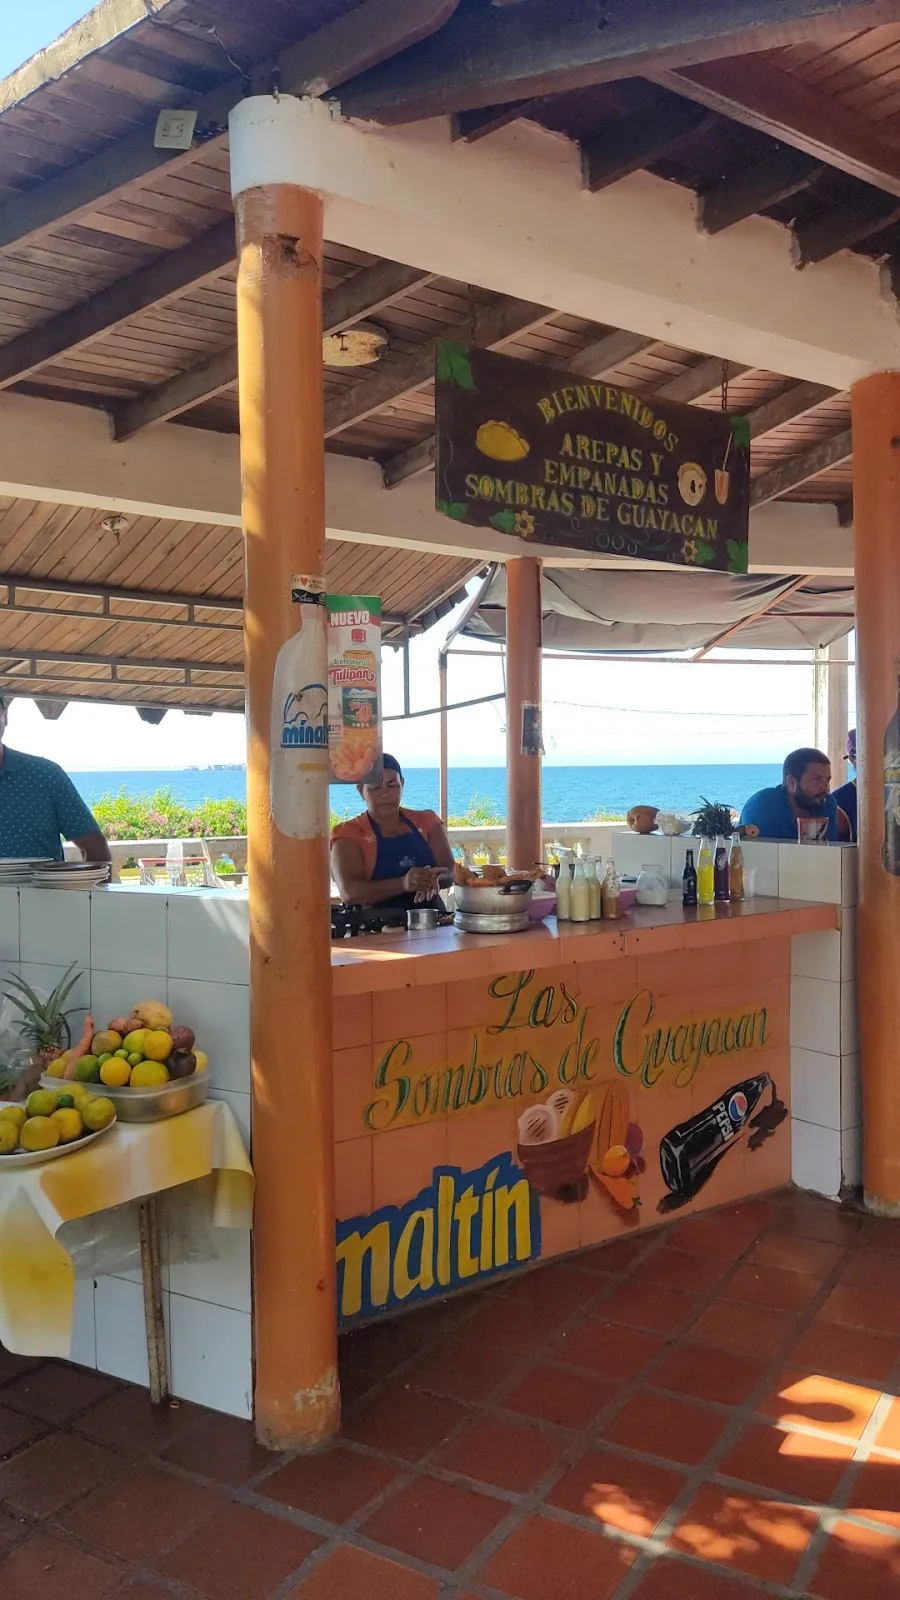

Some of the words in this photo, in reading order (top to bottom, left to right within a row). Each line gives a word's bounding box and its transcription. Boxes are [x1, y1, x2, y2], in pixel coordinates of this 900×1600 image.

[537, 384, 679, 452] BIENVENIDOS
[558, 432, 643, 472] AREPAS
[651, 452, 664, 477] Y
[544, 459, 669, 505] EMPANADAS
[464, 473, 574, 517] SOMBRAS
[580, 495, 610, 522] DE
[616, 503, 718, 540] GUAYACAN
[330, 610, 370, 627] NUEVO
[328, 666, 376, 686] Tulipán
[486, 969, 578, 1035] Las
[363, 1033, 549, 1131] Sombras
[558, 1007, 600, 1085] de
[613, 988, 770, 1088] Guayacan
[712, 1100, 735, 1142] PEPSI
